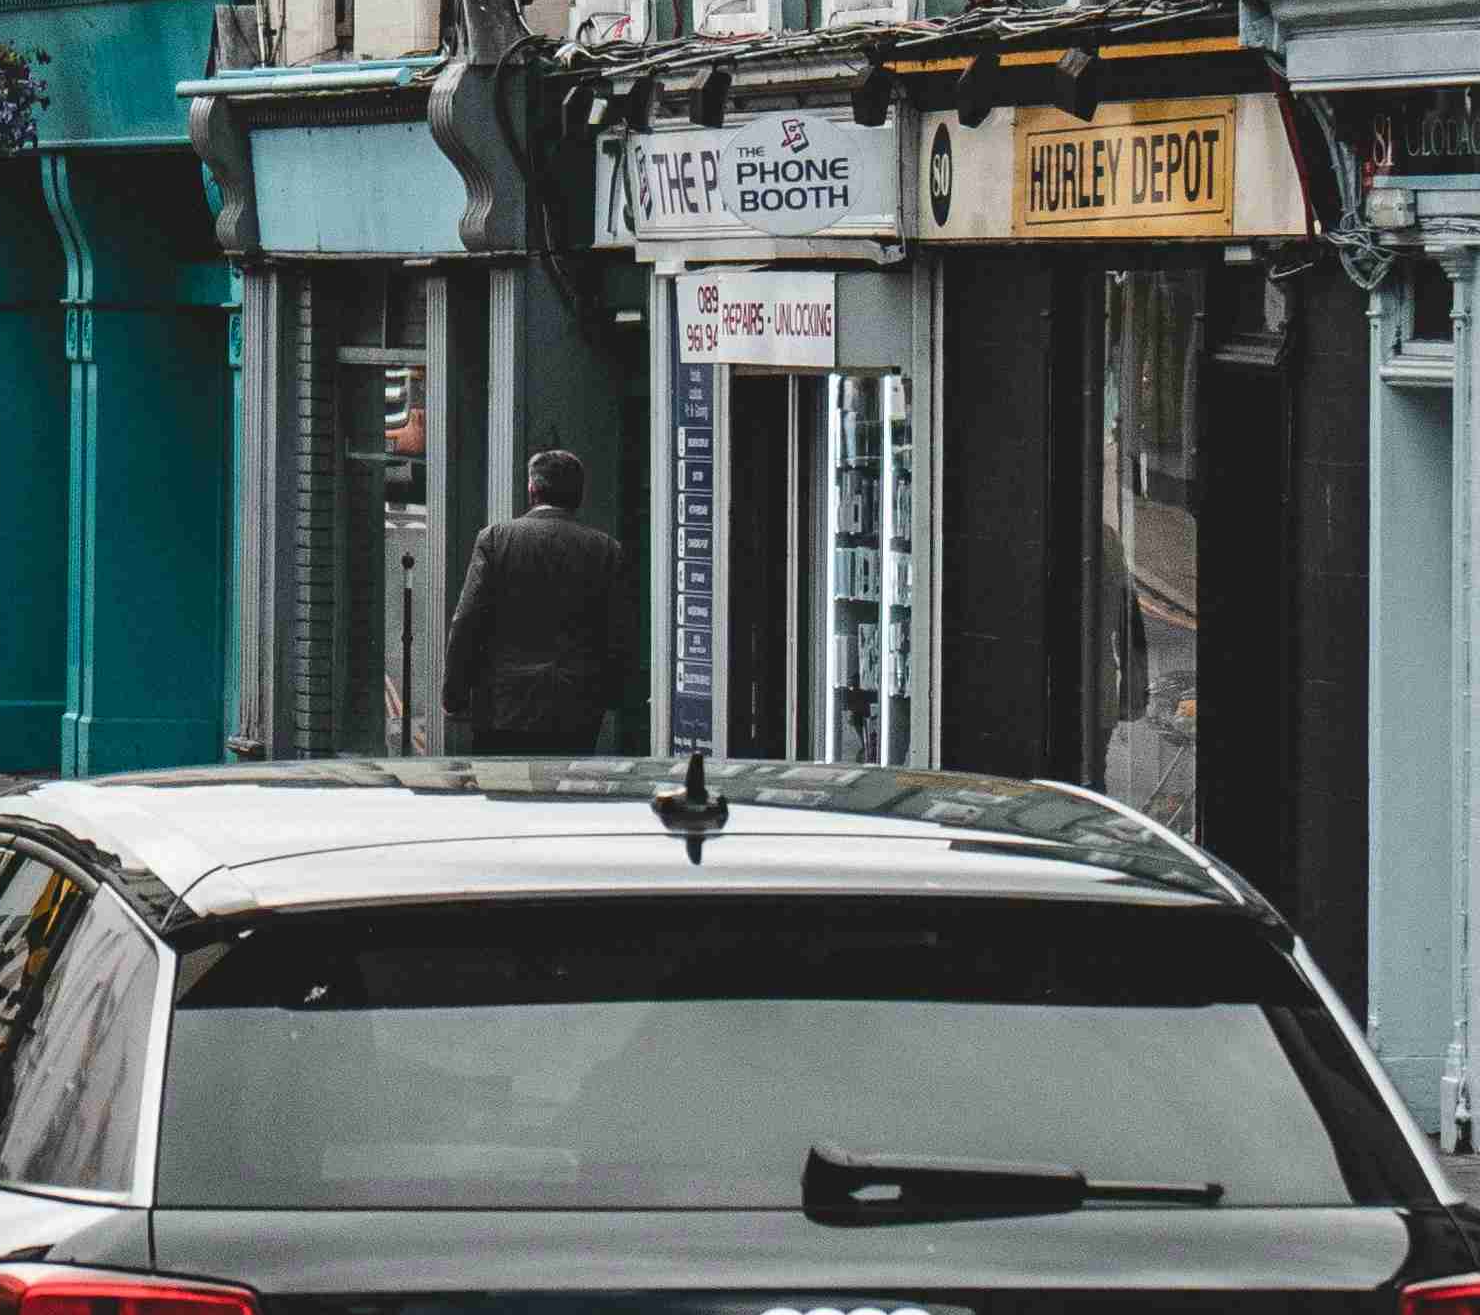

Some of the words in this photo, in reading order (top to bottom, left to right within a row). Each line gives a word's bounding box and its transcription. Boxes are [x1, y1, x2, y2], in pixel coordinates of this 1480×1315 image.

[736, 146, 766, 158] THE
[652, 151, 699, 214] THE
[701, 150, 727, 214] P
[736, 157, 849, 185] PHONE
[932, 154, 951, 198] 80
[1030, 137, 1123, 213] HURLEY
[1131, 129, 1219, 206] DEPOT
[740, 185, 849, 213] BOOTH
[696, 285, 719, 315] 089
[722, 302, 765, 336] REPAIRS
[774, 302, 832, 337] UNLOCKING
